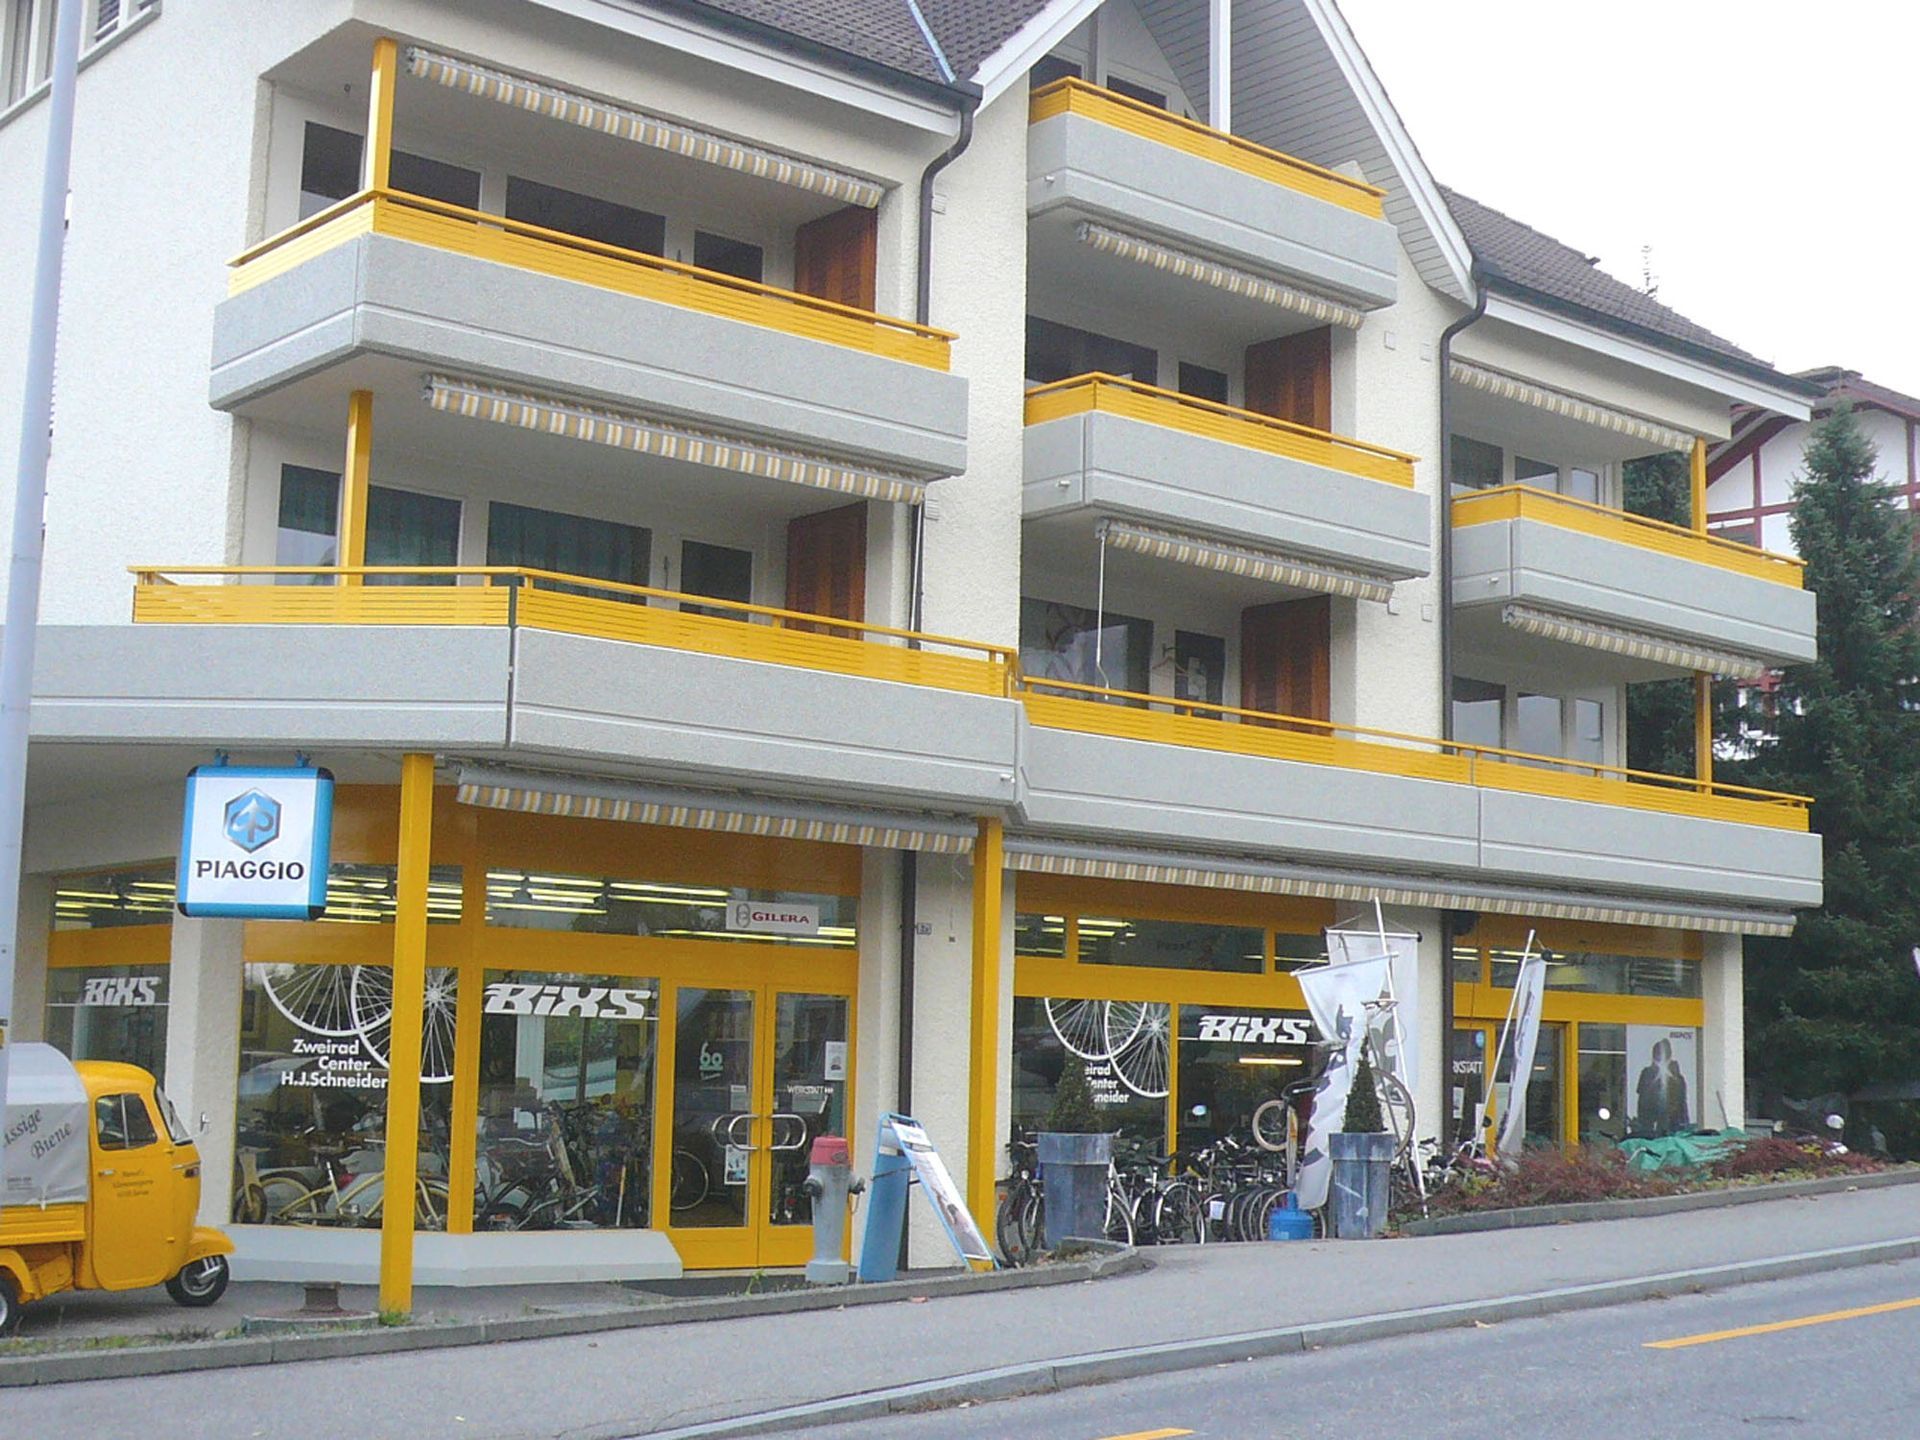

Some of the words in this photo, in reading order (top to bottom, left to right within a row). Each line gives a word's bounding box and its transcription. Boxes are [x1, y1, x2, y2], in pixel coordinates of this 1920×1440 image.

[196, 860, 305, 880] PIAGGIO
[752, 911, 809, 924] GILERA
[292, 1038, 360, 1055] Zweirad
[318, 1056, 371, 1071] Center
[1084, 1062, 1111, 1076] eirad
[30, 1122, 73, 1160] Biene
